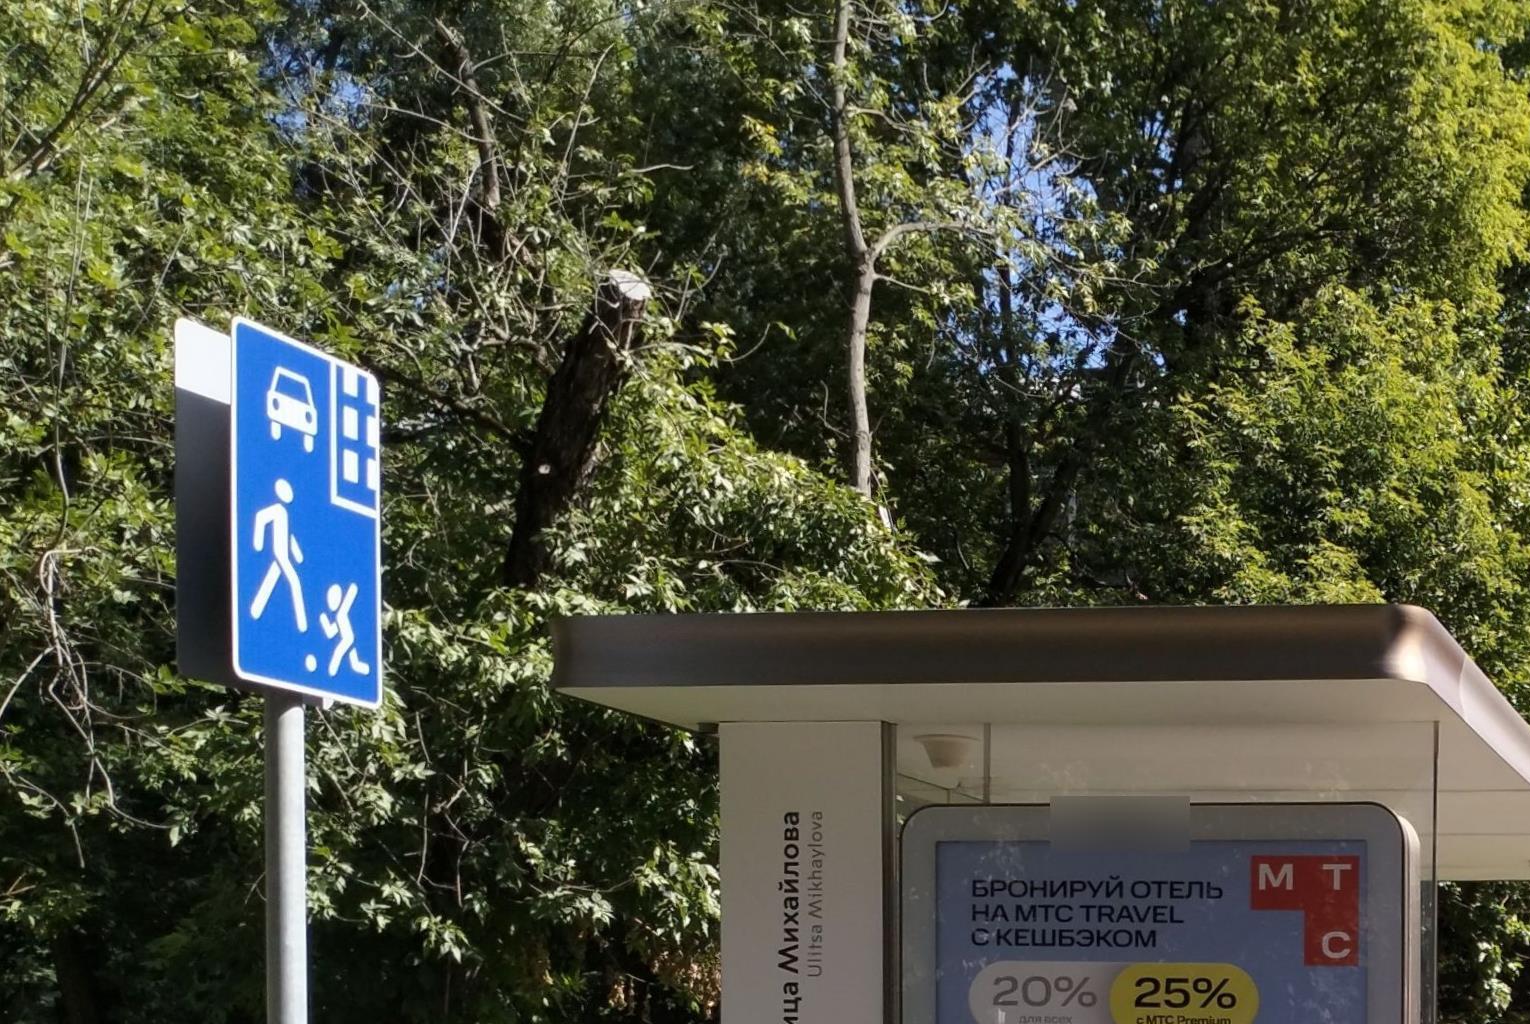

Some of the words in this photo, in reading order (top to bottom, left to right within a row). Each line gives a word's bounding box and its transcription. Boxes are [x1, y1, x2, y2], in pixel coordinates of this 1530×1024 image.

[807, 810, 826, 918] Mikhaylova
[778, 811, 800, 974] Михайлова
[971, 876, 1124, 900] БРОНИРУЙ
[1130, 881, 1223, 900] ОТЕЛЬ
[971, 904, 1011, 924] НА
[1014, 904, 1079, 924] МТС
[1084, 905, 1185, 925] TRAVEL
[807, 924, 822, 977] Ulitsa
[971, 928, 990, 947] С
[996, 928, 1158, 949] КЕШБЭКОМ
[991, 975, 1098, 1008] 20%
[1133, 977, 1238, 1010] 25%
